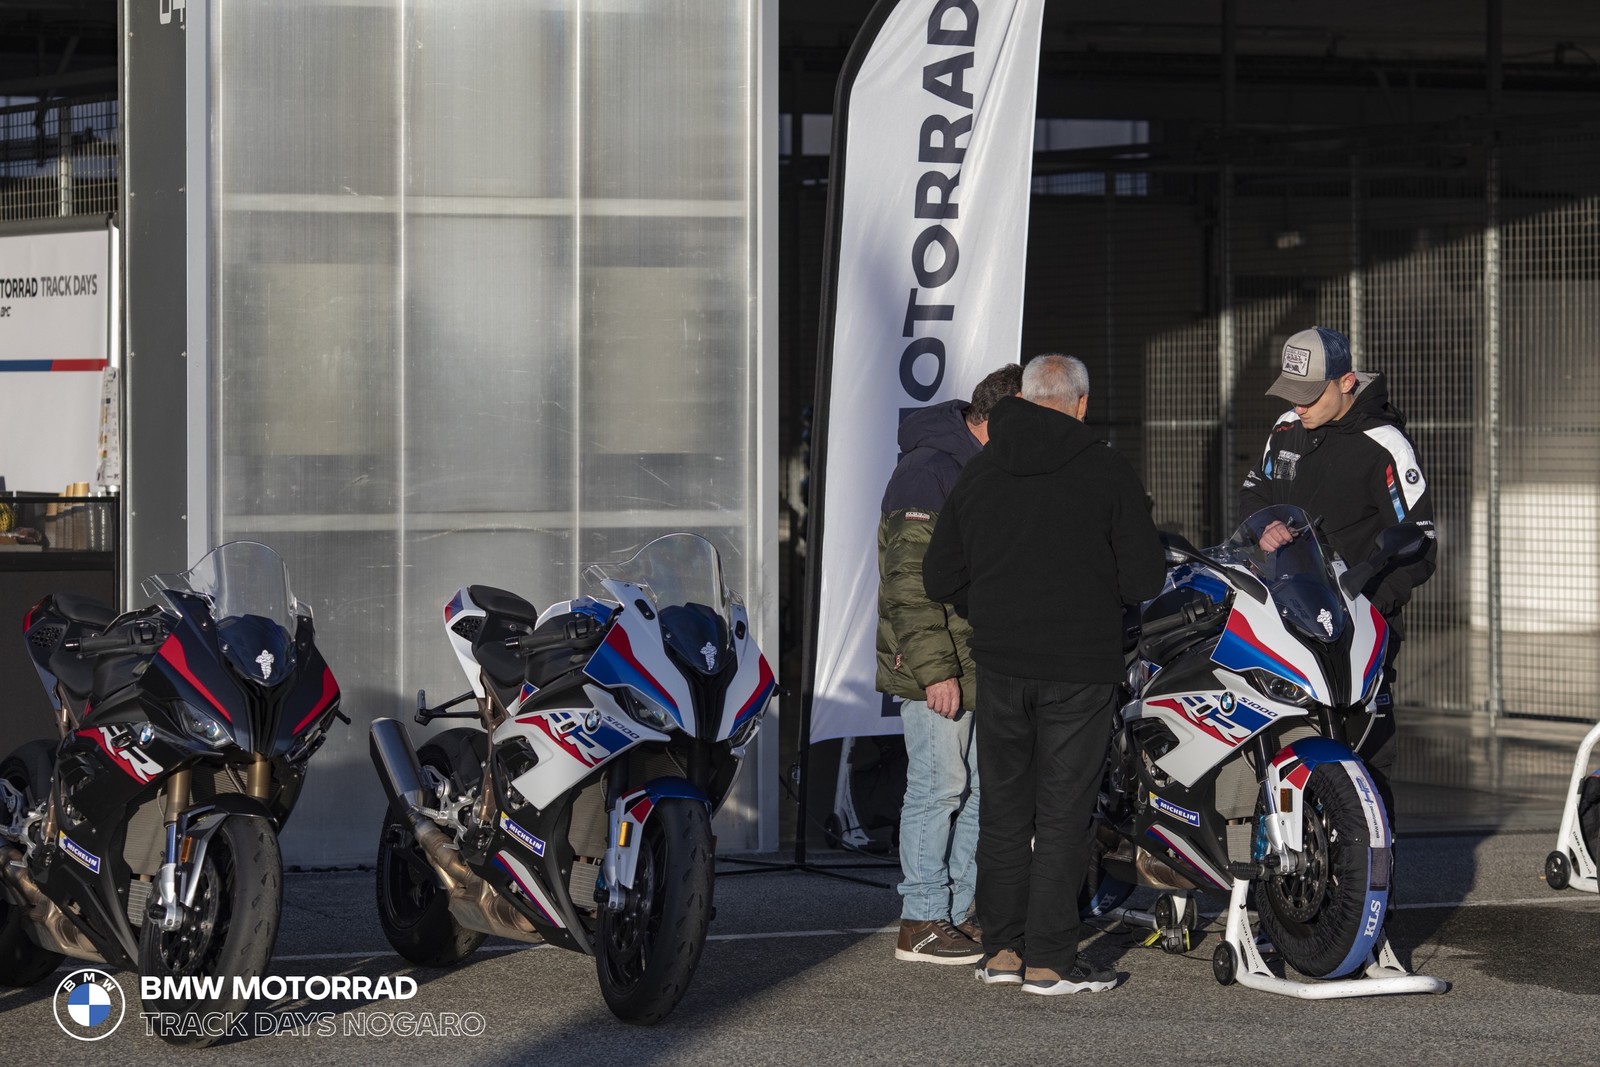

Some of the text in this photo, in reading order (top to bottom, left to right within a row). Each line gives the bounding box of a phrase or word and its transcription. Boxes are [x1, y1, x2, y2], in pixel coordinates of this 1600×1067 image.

[897, 0, 979, 455] OTORRAD
[41, 275, 72, 297] TRACK
[73, 273, 98, 296] DAYS
[1160, 801, 1197, 822] MICHELIN
[508, 823, 543, 850] MICHELIN
[66, 842, 98, 867] MICHELIN
[1363, 899, 1381, 938] KLS
